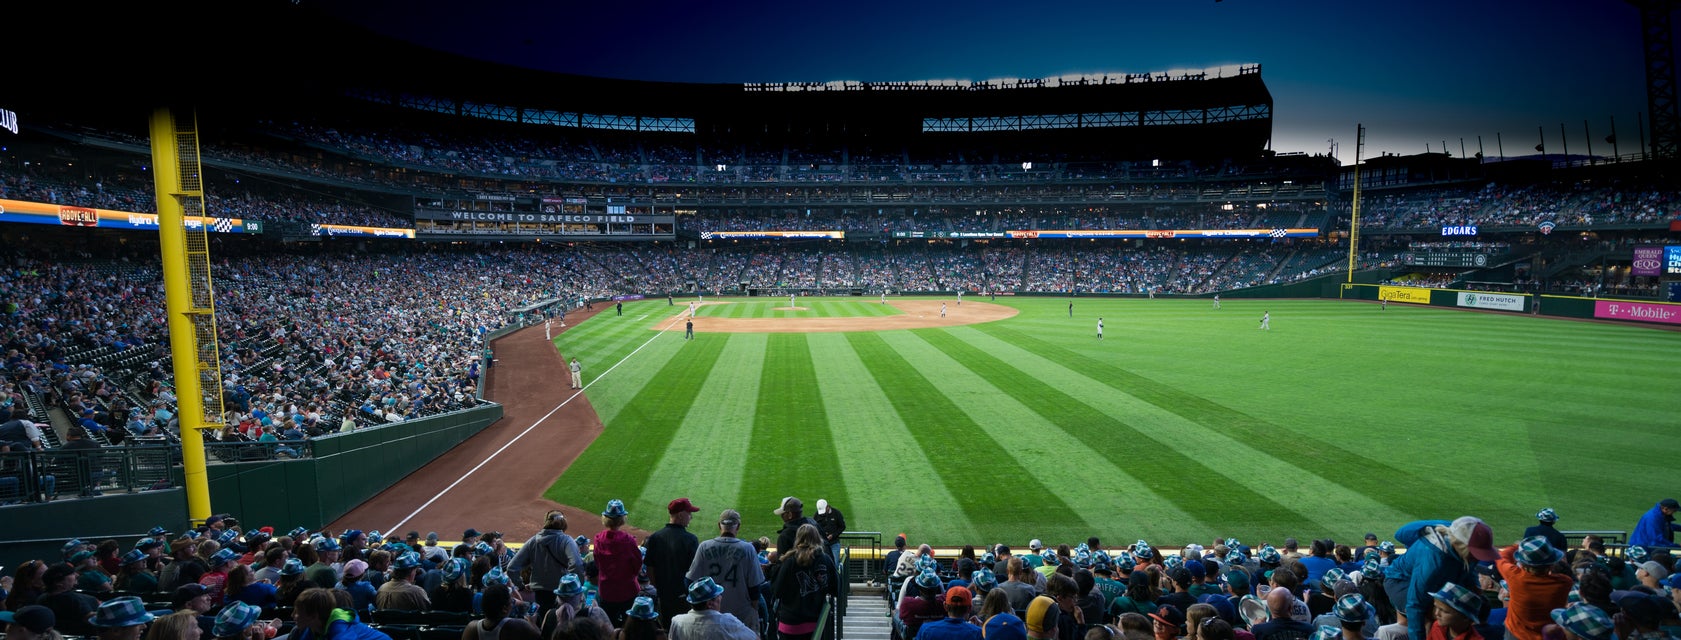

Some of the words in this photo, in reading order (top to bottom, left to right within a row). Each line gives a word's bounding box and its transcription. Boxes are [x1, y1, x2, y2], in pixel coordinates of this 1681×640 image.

[128, 214, 152, 226] Hydro
[452, 211, 513, 221] WELCOME
[540, 214, 591, 222] SAFECO
[1442, 226, 1477, 236] EDGARS
